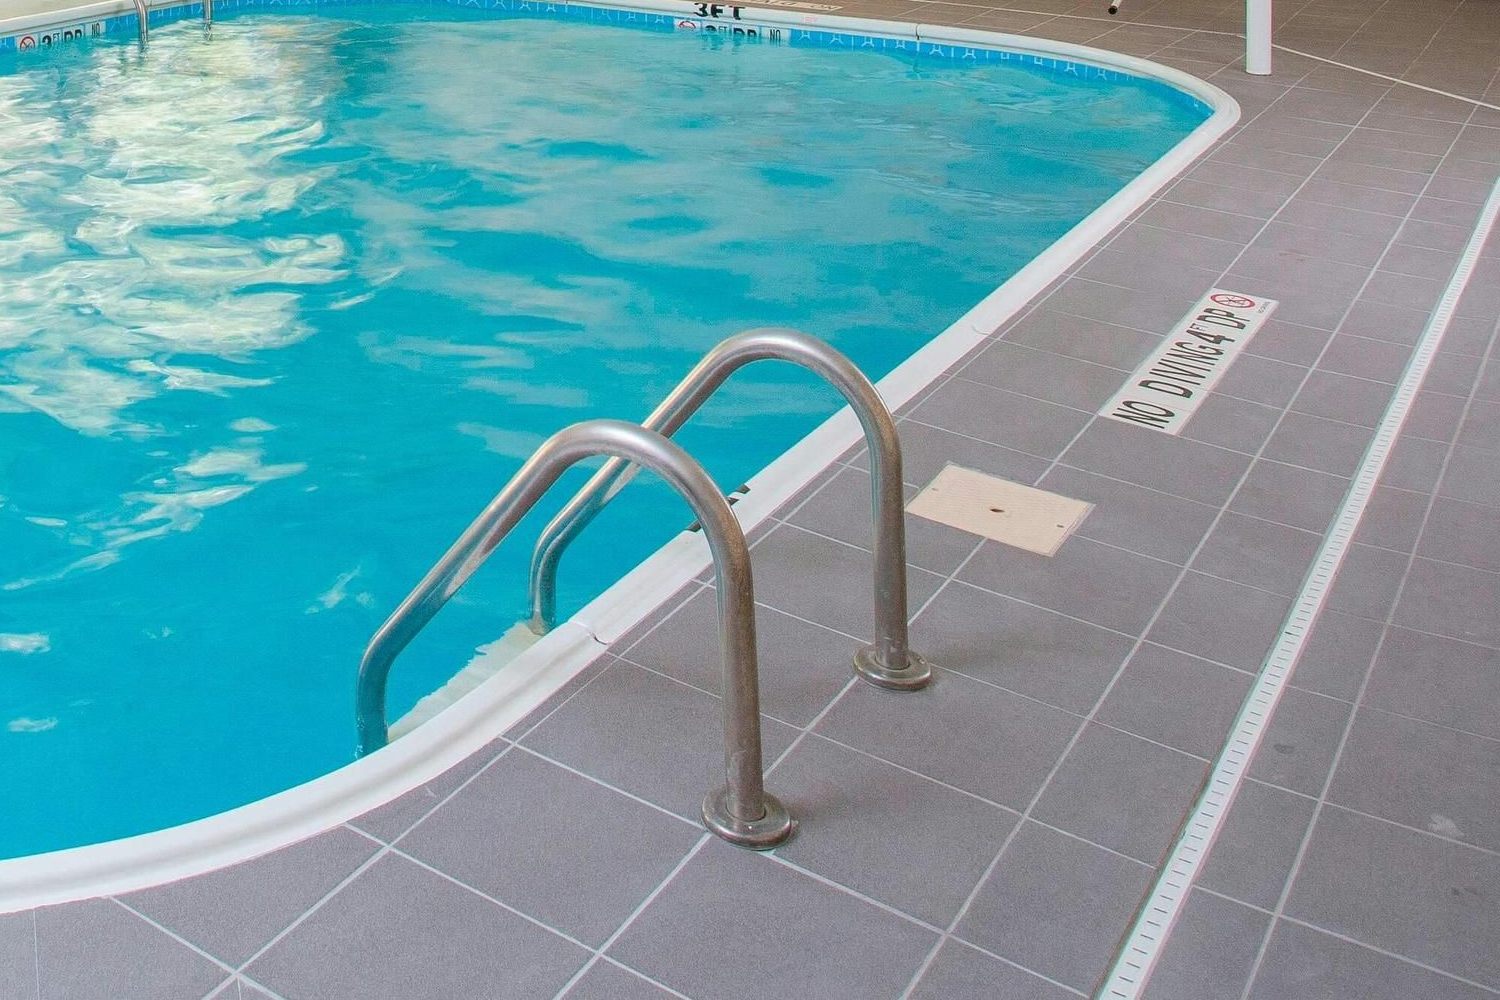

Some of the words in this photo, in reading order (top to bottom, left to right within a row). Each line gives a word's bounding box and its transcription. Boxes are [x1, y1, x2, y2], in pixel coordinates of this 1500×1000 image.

[693, 2, 746, 20] 3FT
[1196, 307, 1250, 330] DP
[1138, 341, 1224, 399] DIVING
[1112, 400, 1175, 429] NO
